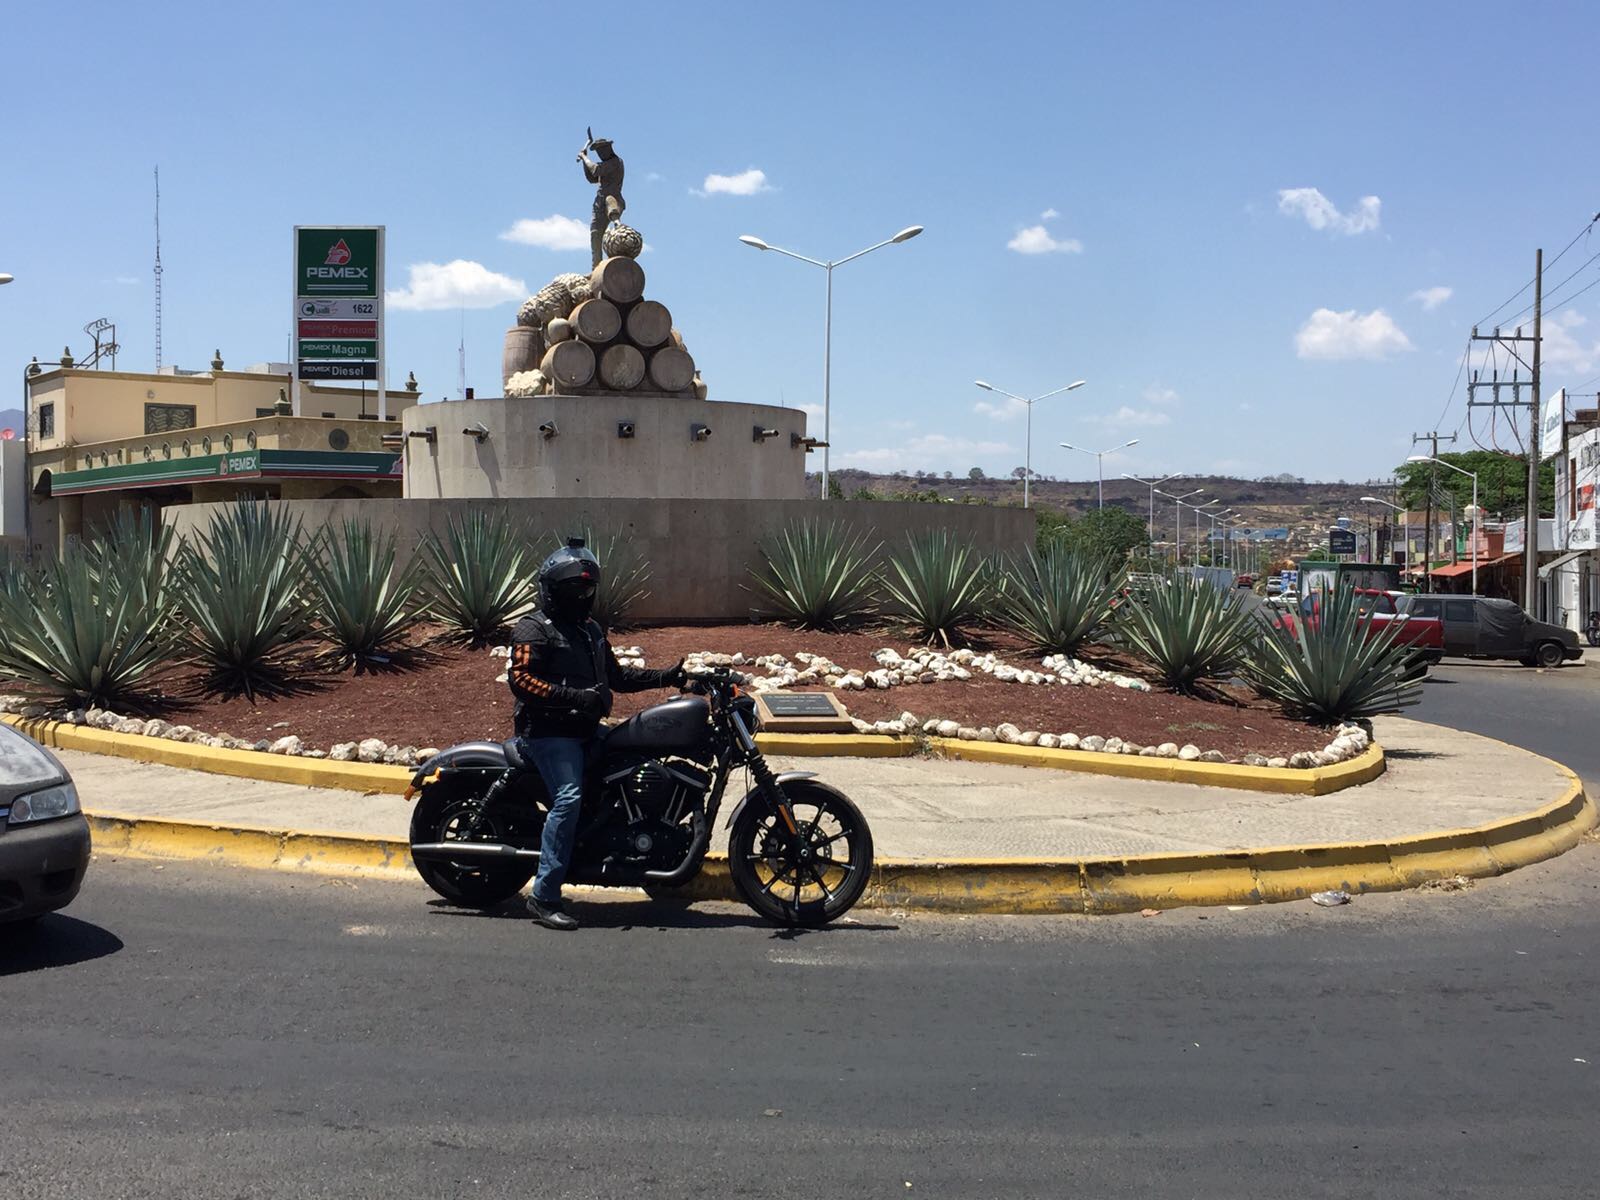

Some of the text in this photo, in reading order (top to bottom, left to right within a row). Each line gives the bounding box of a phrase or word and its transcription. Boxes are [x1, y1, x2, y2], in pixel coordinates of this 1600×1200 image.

[306, 267, 368, 278] PEMEX
[352, 304, 373, 314] 1622
[332, 344, 367, 356] Magna
[332, 366, 364, 376] Diesel
[229, 456, 257, 471] PEMEX
